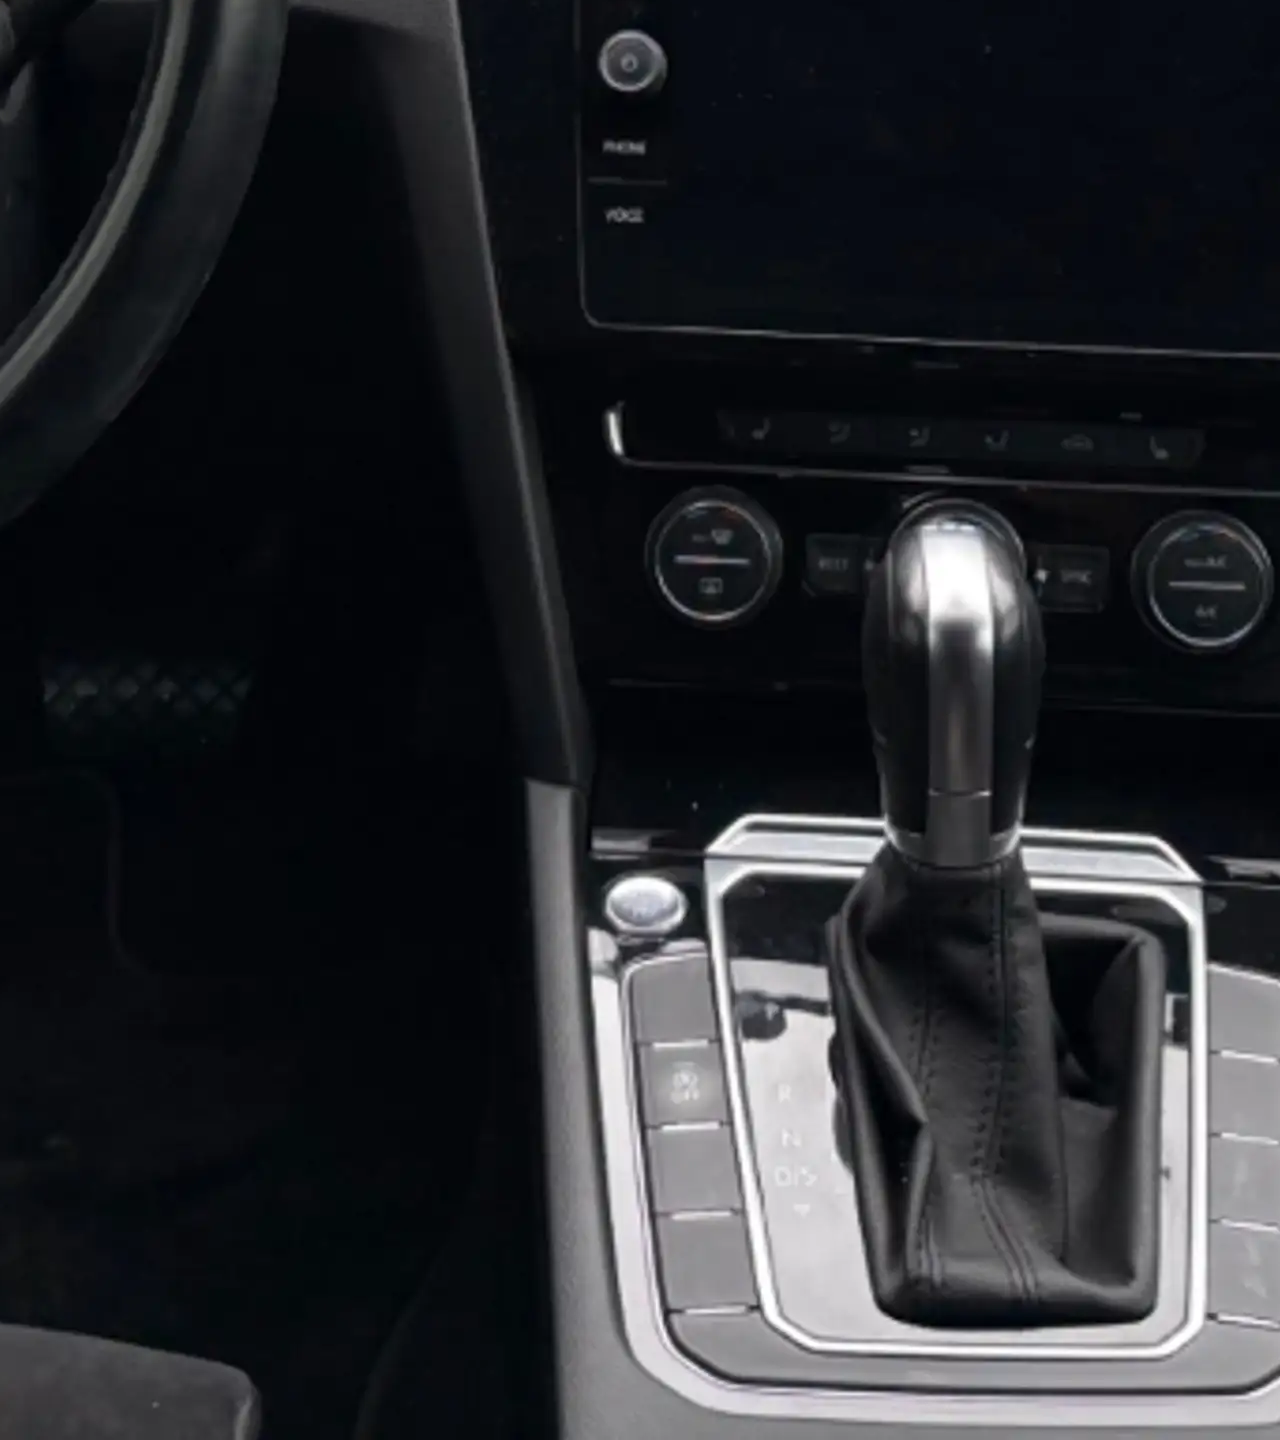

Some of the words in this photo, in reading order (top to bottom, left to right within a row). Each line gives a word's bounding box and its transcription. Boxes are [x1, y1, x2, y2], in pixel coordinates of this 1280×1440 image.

[603, 205, 646, 225] VOICE
[777, 1083, 792, 1104] R
[781, 1128, 801, 1149] N
